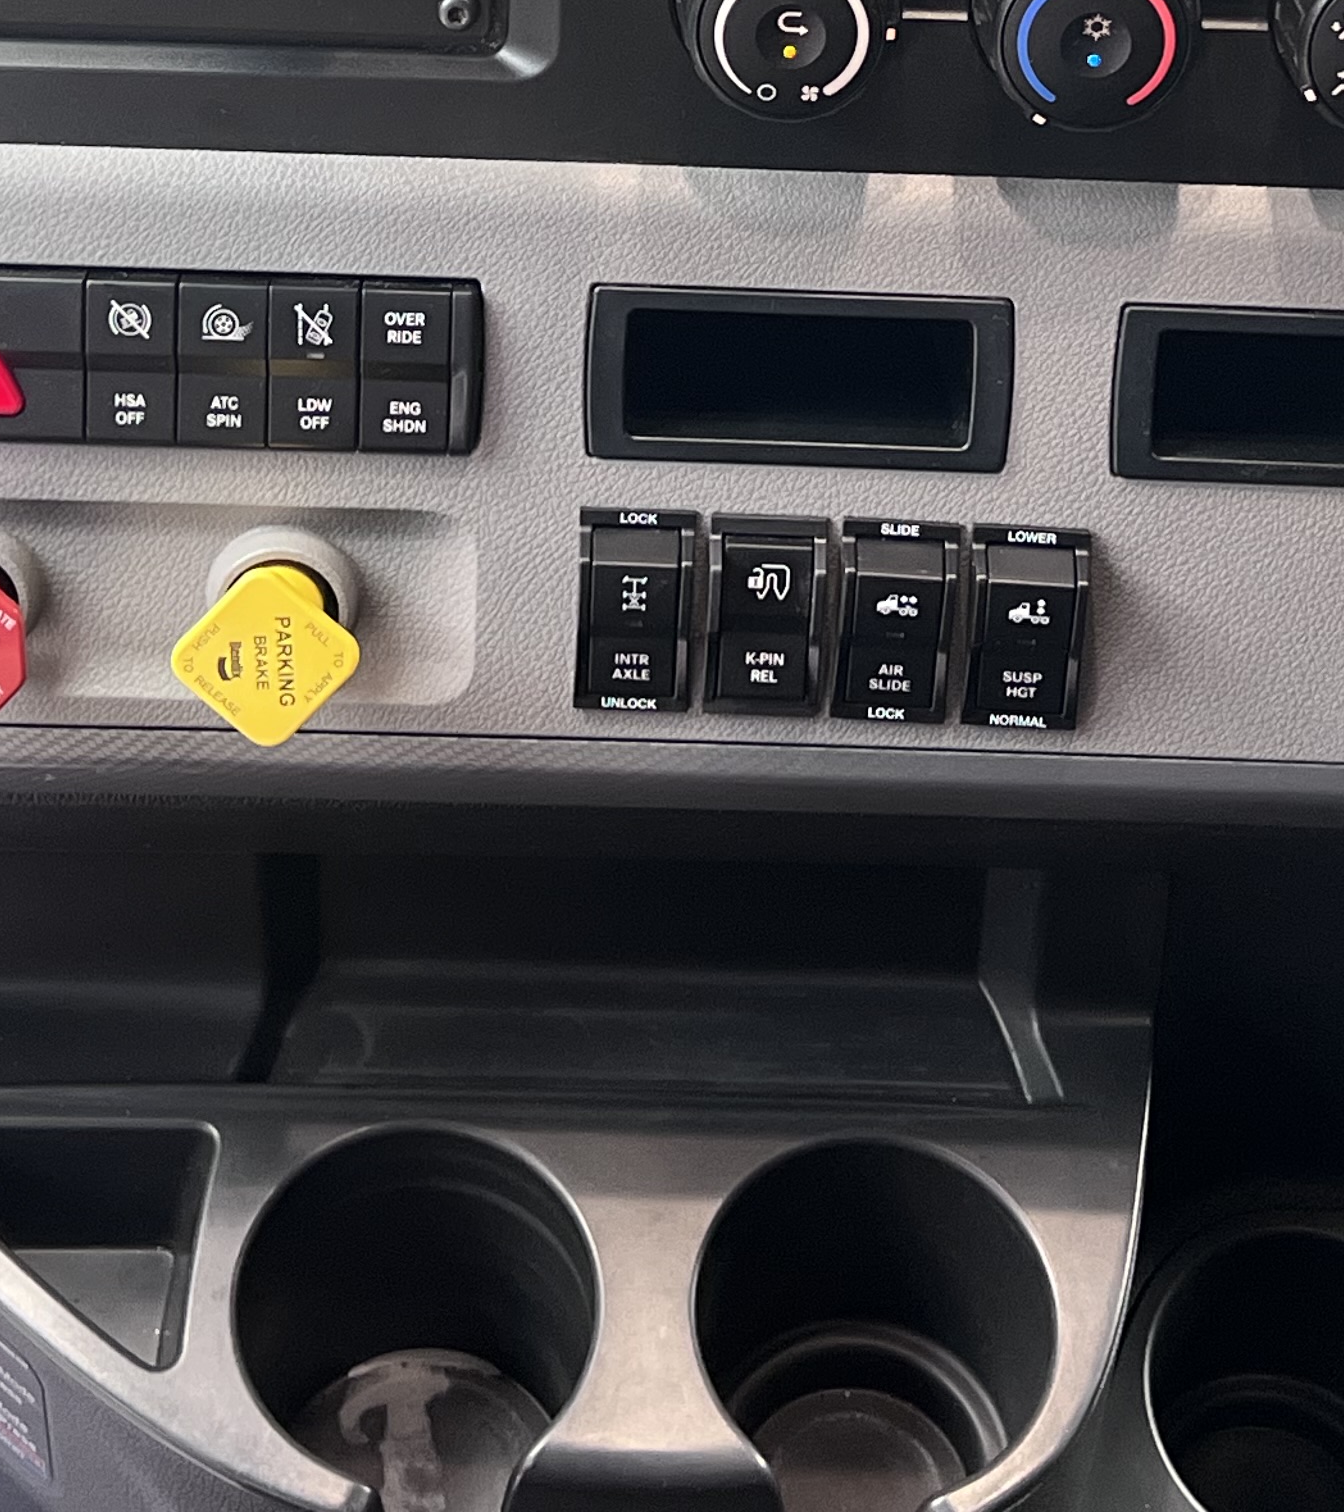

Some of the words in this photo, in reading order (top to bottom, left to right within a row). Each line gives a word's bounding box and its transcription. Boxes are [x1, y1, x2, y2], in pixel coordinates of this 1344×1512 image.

[384, 312, 426, 327] OVER
[387, 329, 423, 344] RIDE
[114, 393, 146, 408] HSA
[210, 396, 239, 411] ATC
[297, 398, 333, 413] LDW
[389, 401, 421, 416] ENG
[115, 411, 144, 425] OFF
[206, 413, 242, 428] SPIN
[299, 415, 330, 429] OFF
[383, 418, 426, 433] SHDN
[619, 512, 658, 526] LOCK
[880, 523, 920, 536] SLIDE
[1007, 530, 1056, 544] LOWER
[192, 623, 220, 651] PUSH
[304, 622, 330, 647] PULL
[183, 656, 194, 673] TO
[229, 641, 243, 679] Bendix
[254, 635, 270, 690] BRAKE
[275, 616, 295, 706] PARKING
[334, 651, 344, 668] TO
[614, 652, 649, 666] INTR
[745, 651, 785, 666] K-PIN
[612, 666, 650, 682] AXLE
[750, 669, 778, 684] REL
[878, 664, 904, 678] AIR
[1002, 671, 1042, 685] SUSP
[304, 672, 334, 703] APPLY
[868, 677, 911, 692] SLIDE
[1006, 685, 1037, 699] HGT
[194, 675, 241, 717] RELEASE
[601, 697, 657, 710] UNLOCK
[867, 707, 905, 720] LOCK
[989, 713, 1046, 727] NORMAL
